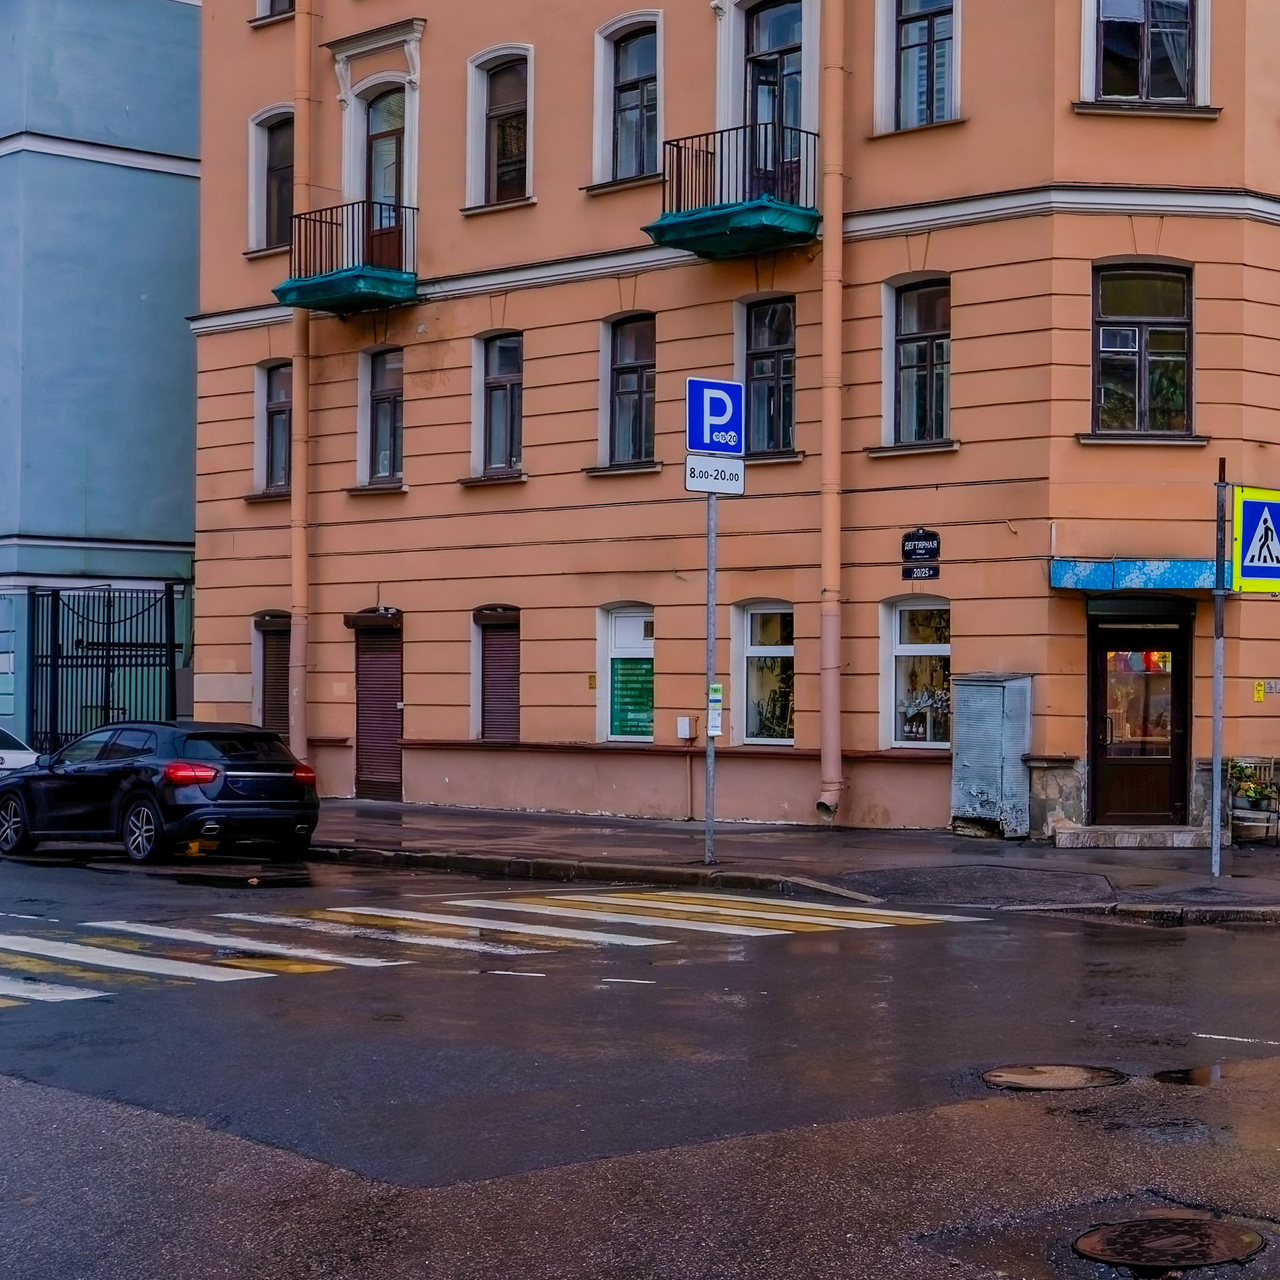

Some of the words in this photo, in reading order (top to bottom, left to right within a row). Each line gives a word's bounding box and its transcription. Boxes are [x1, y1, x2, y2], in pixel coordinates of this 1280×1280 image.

[704, 388, 733, 443] P
[728, 434, 736, 443] 20
[690, 467, 740, 482] 8.00-20.00
[904, 540, 938, 550] ДЕГТЯРНАЯ
[914, 568, 929, 577] 20/25
